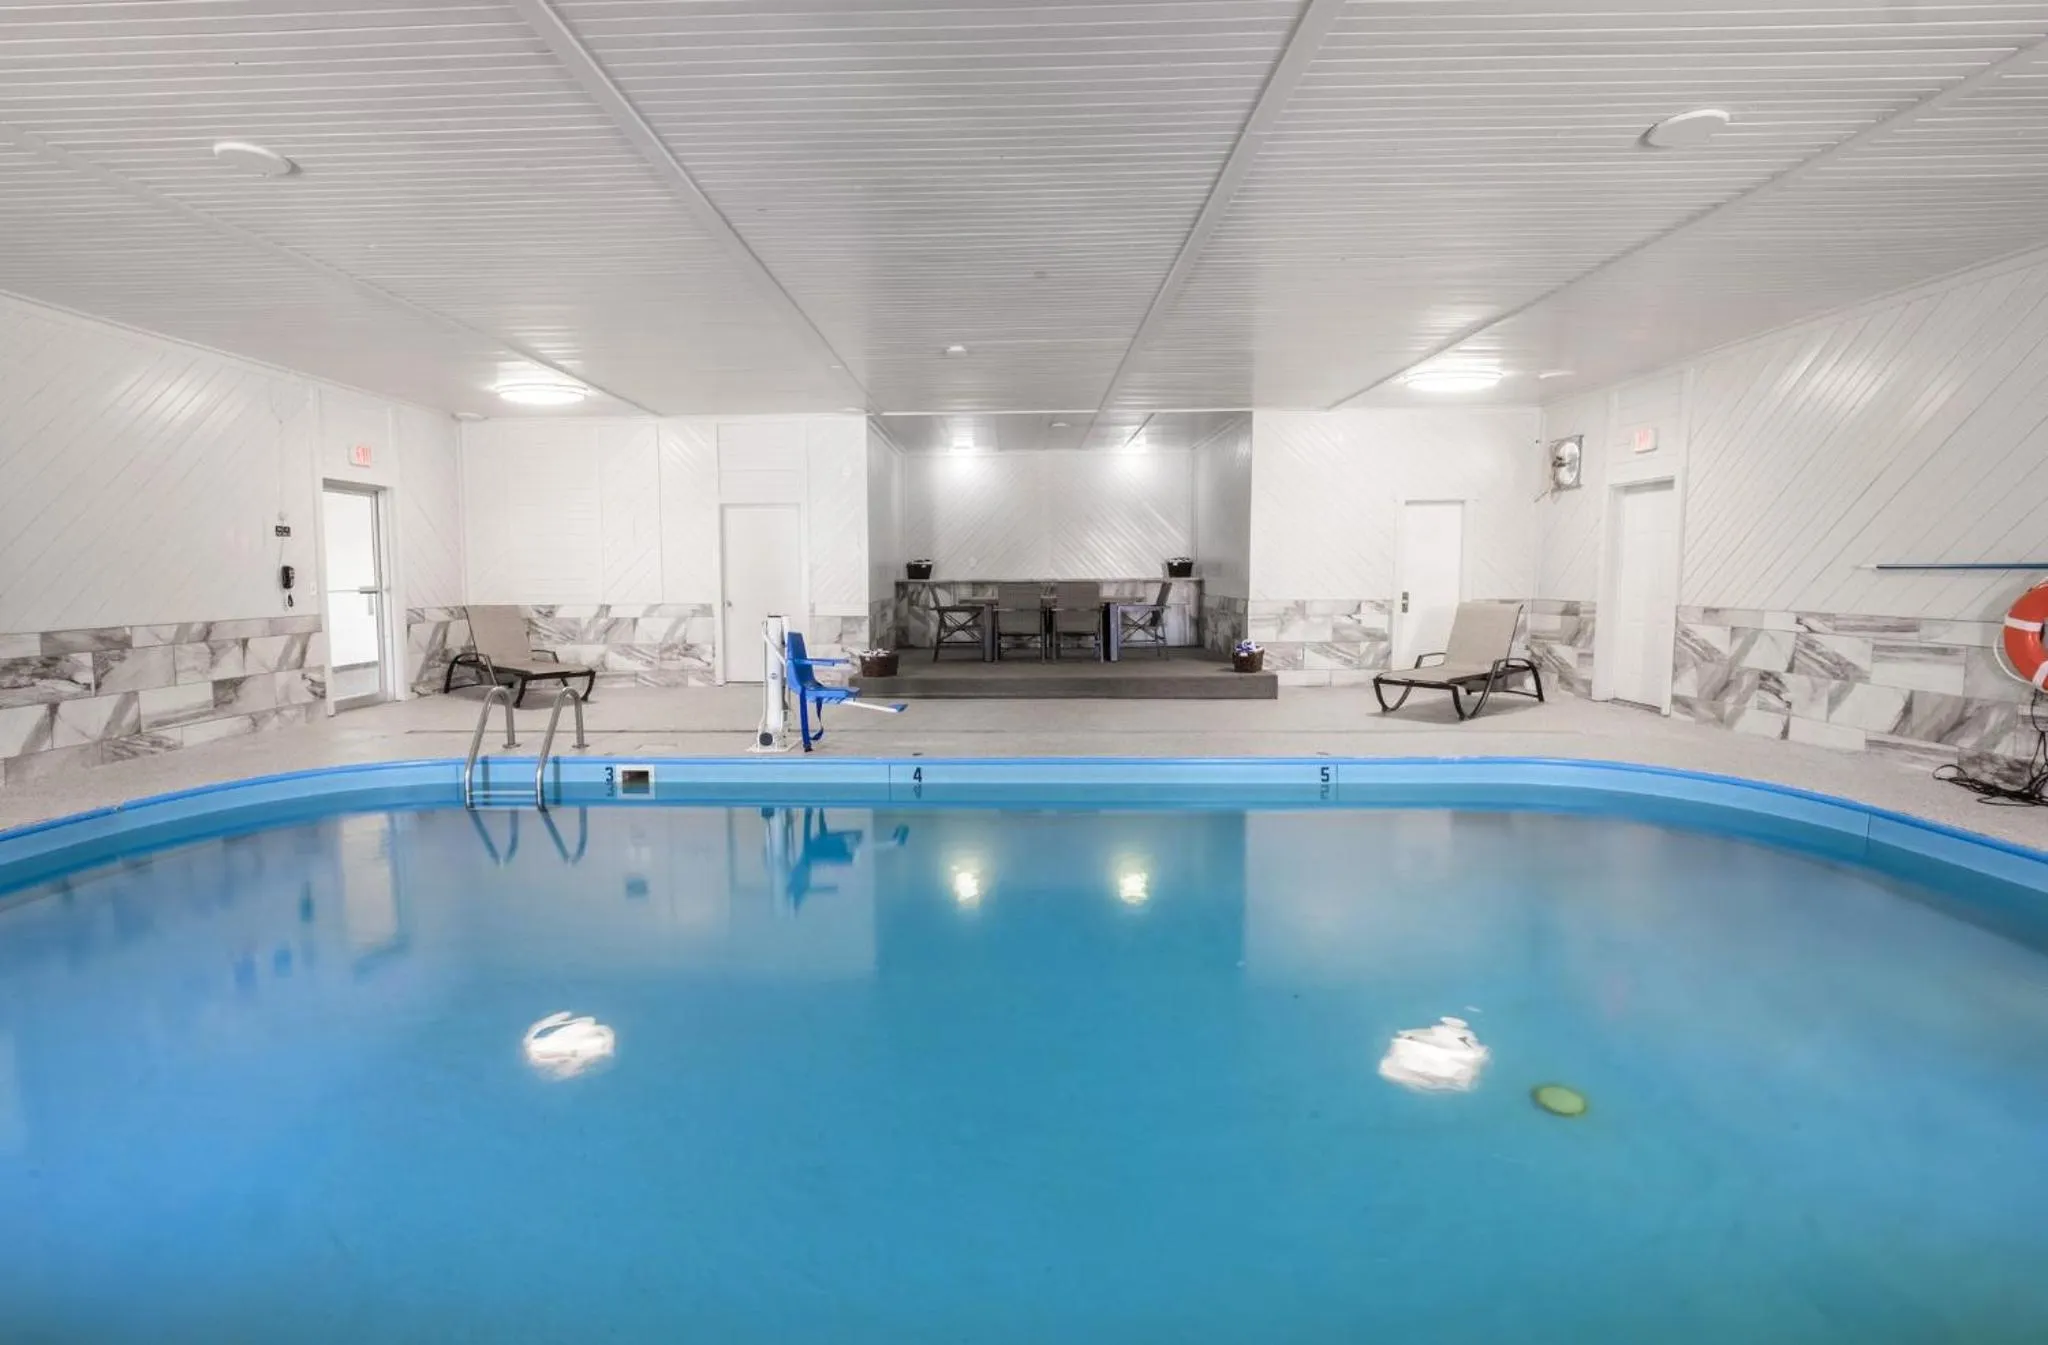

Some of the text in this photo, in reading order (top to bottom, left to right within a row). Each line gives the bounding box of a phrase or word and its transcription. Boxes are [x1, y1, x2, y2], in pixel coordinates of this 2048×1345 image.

[605, 766, 614, 783] 3
[912, 766, 922, 783] 4
[1320, 766, 1330, 783] 5
